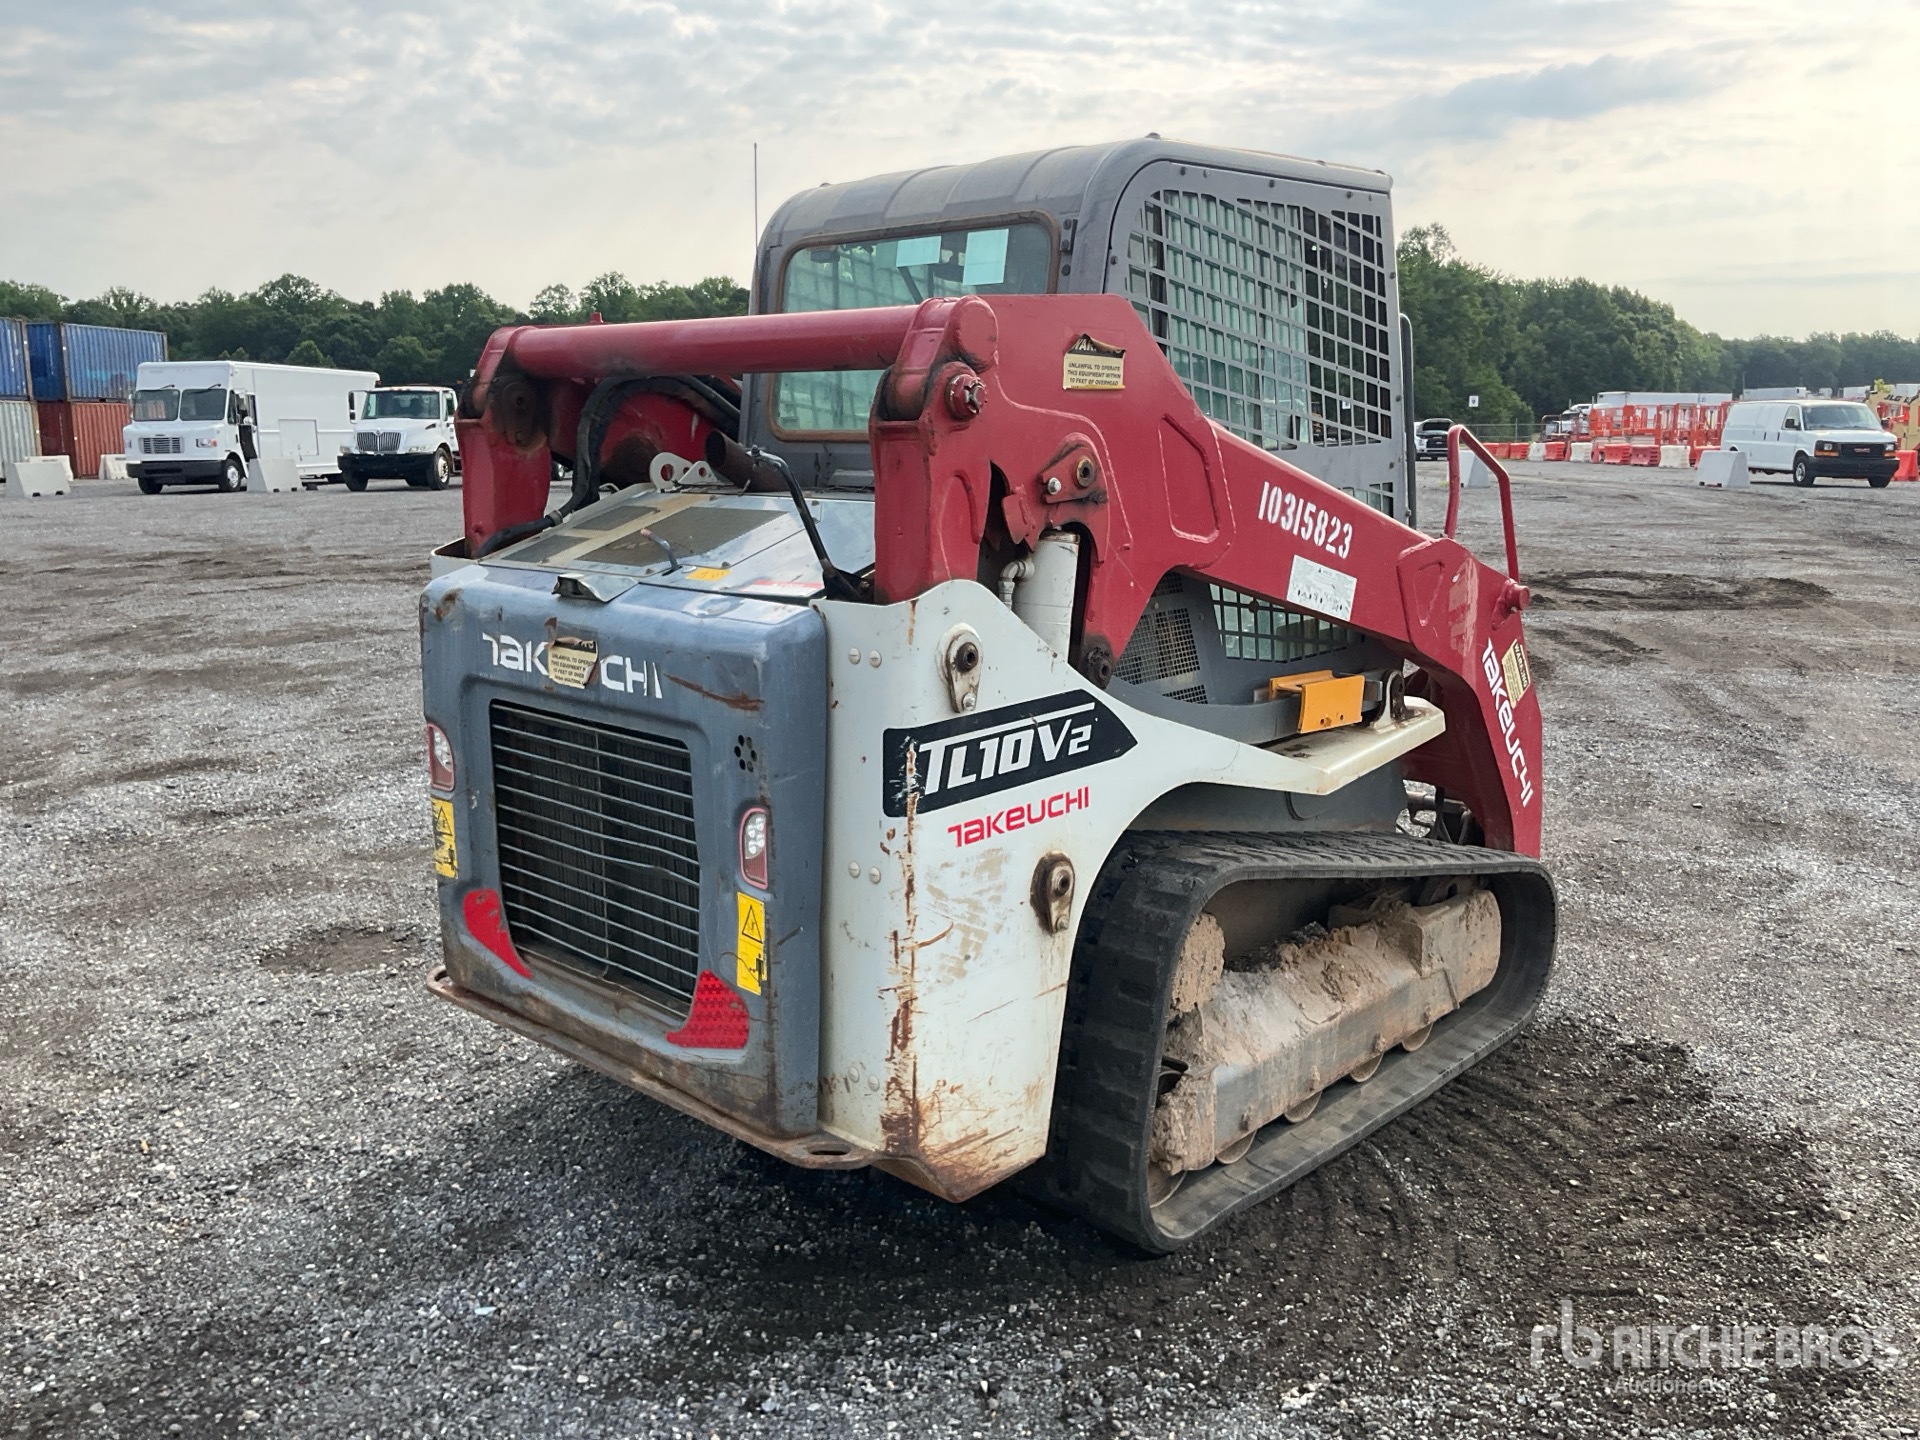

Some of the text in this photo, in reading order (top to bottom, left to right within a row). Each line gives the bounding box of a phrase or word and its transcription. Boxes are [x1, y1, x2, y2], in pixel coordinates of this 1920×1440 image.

[1069, 362, 1093, 370] UNLAWFUL
[1258, 481, 1353, 559] 10315823
[482, 632, 663, 699] TAKCHI
[919, 702, 1095, 795] TL10V2
[1482, 638, 1533, 807] TAKEUCHI
[947, 786, 1089, 847] TAKEUCHI
